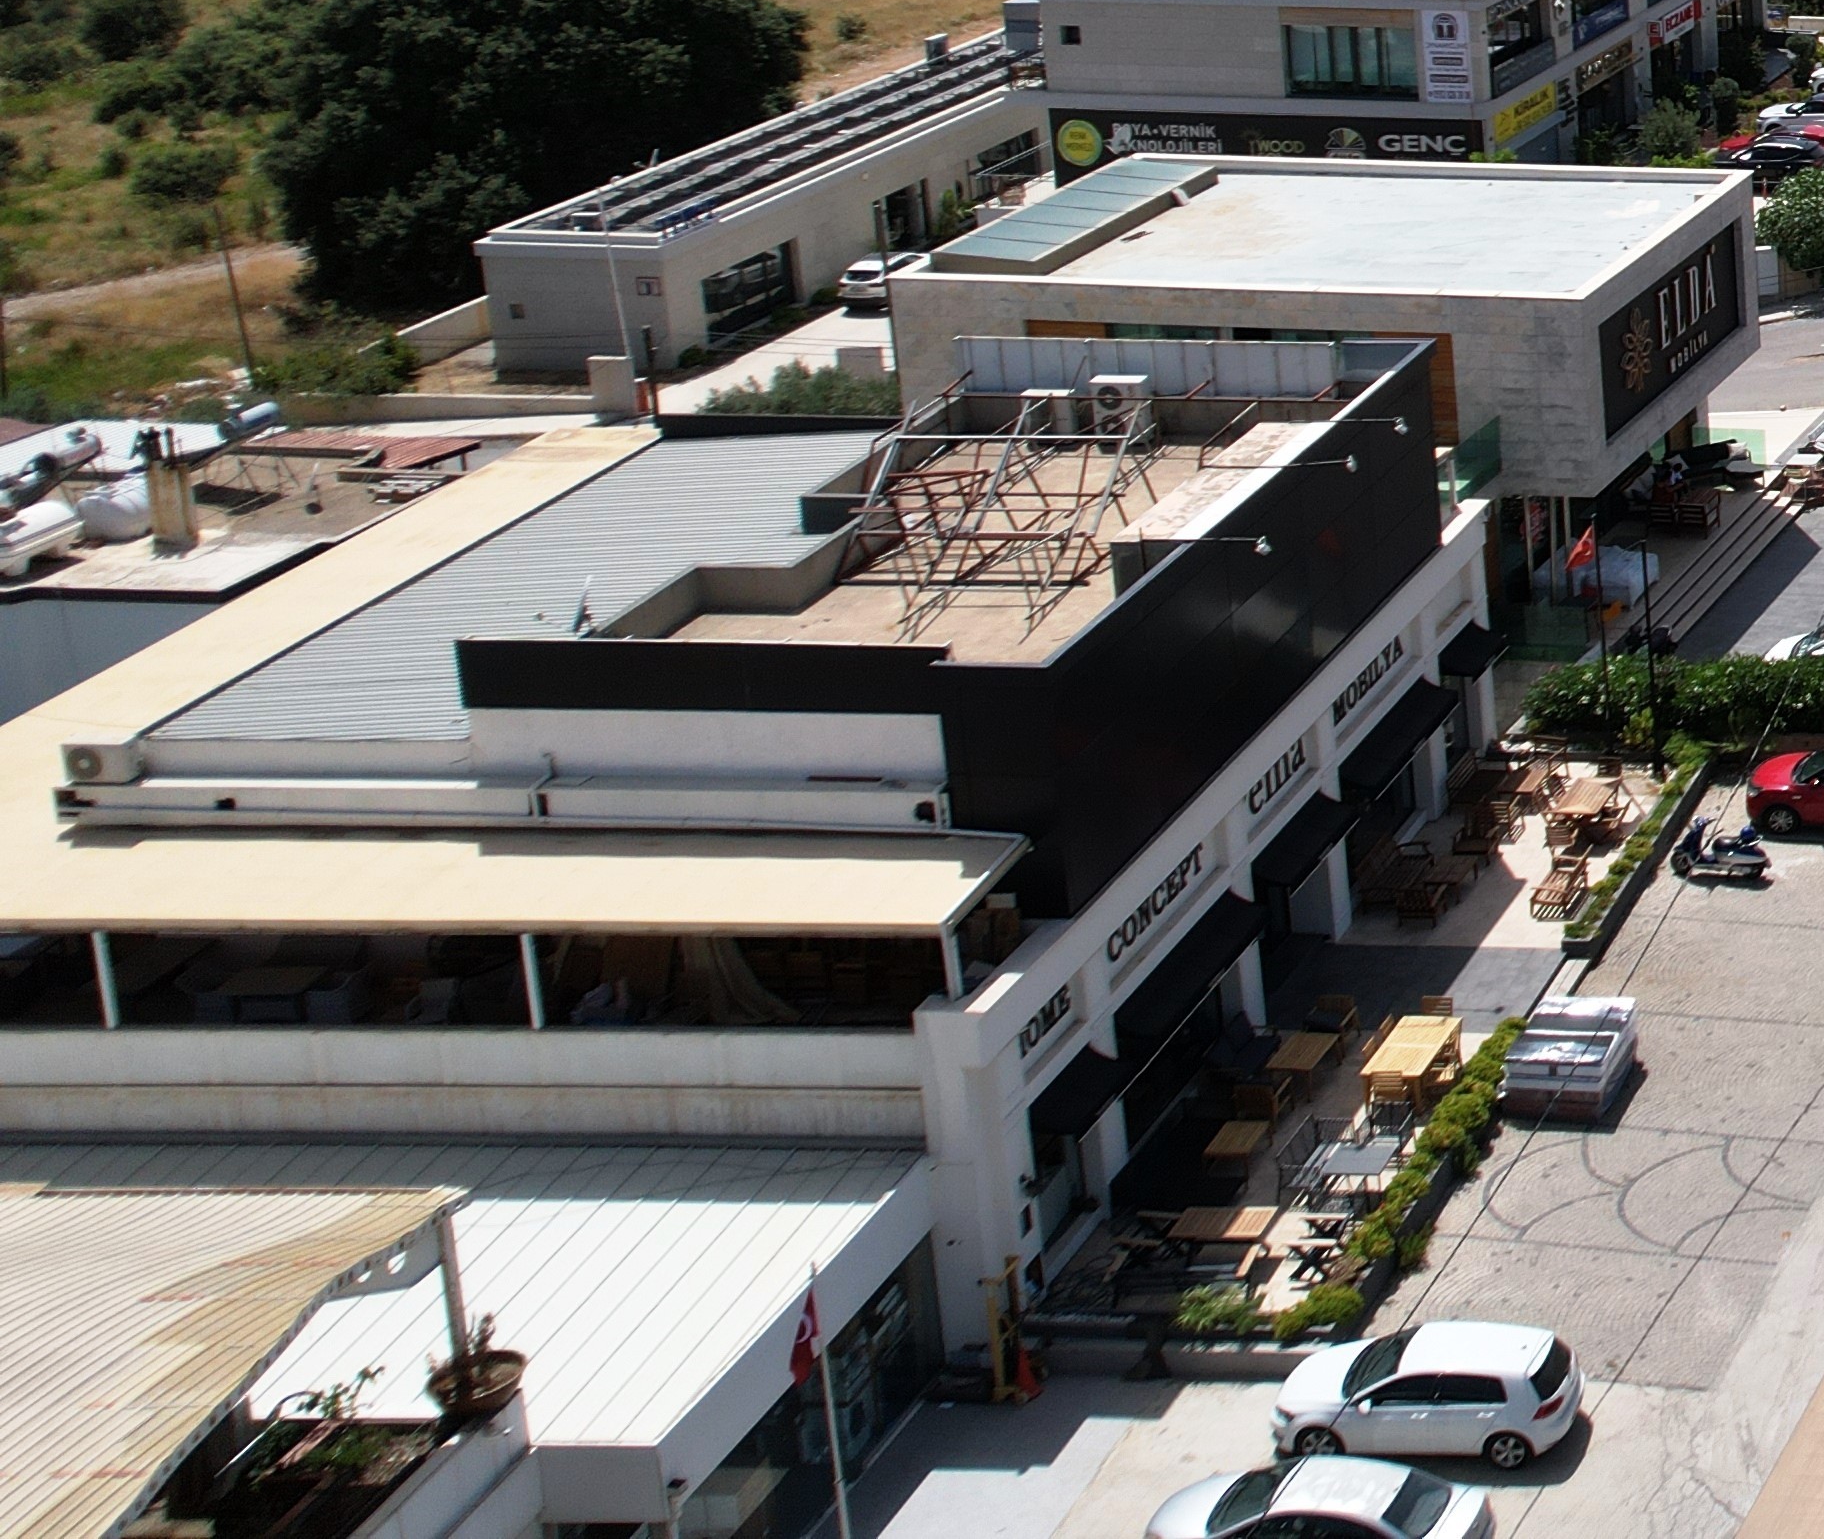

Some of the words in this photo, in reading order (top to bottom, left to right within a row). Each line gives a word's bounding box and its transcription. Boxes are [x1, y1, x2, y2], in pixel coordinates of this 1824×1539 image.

[1665, 0, 1695, 31] ECZANE
[1377, 134, 1467, 156] GENÇ
[1658, 252, 1717, 350] ELDA
[1107, 841, 1204, 962] CONCEPT
